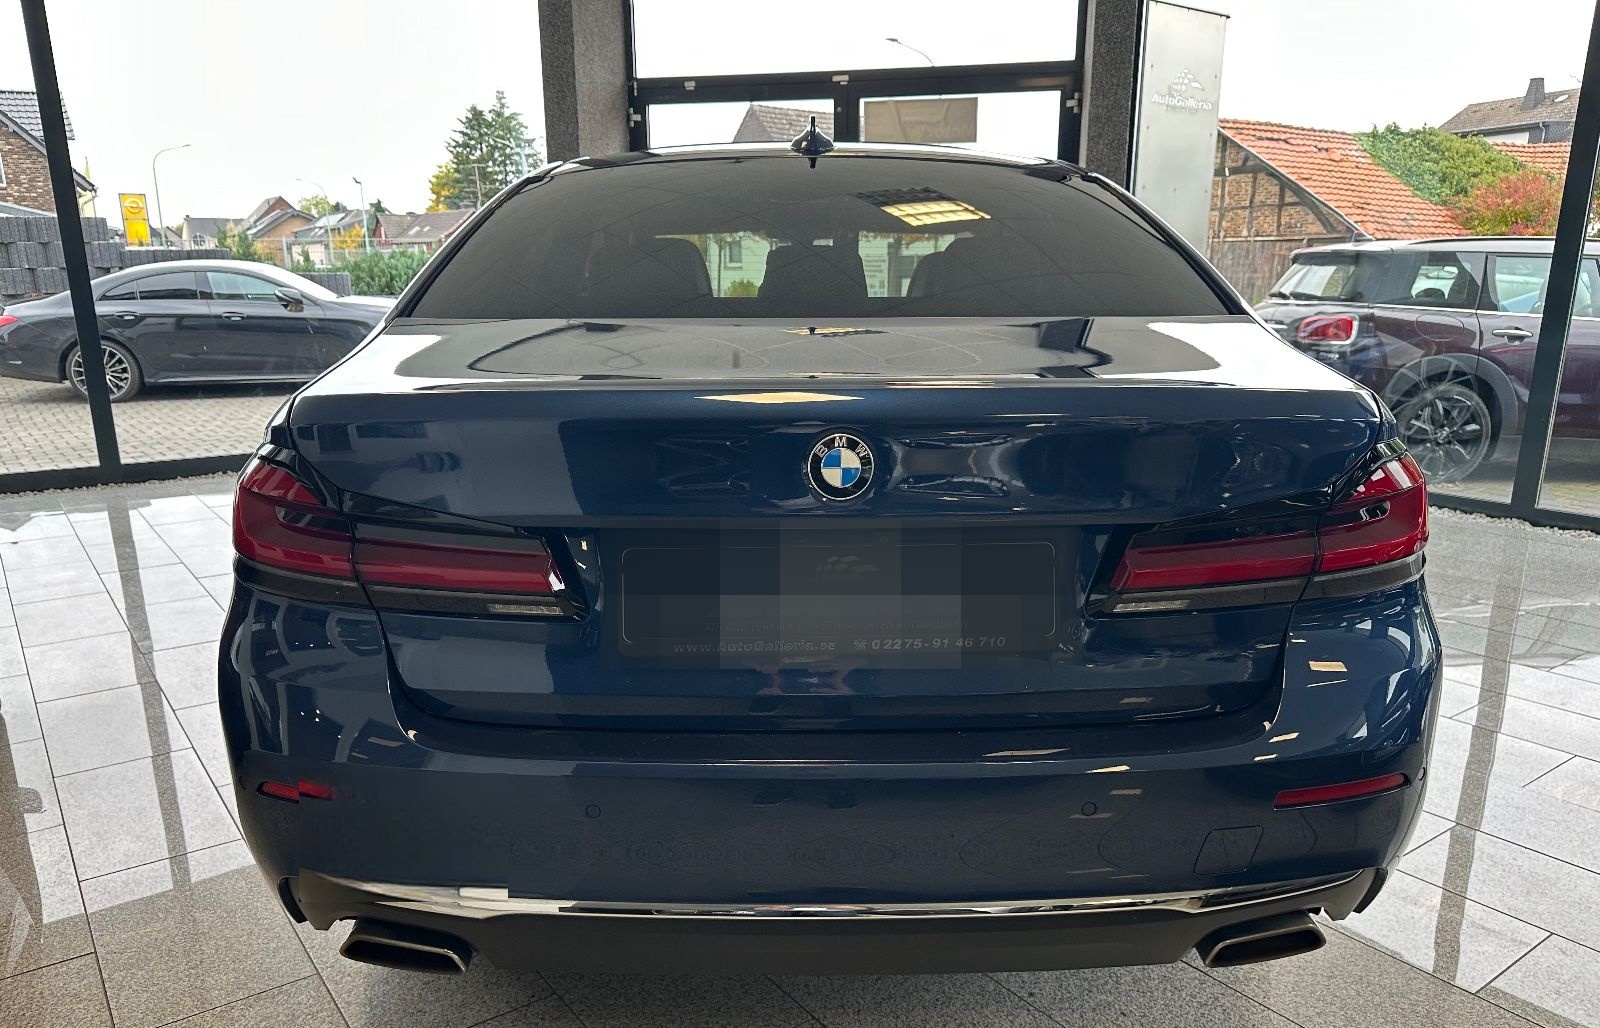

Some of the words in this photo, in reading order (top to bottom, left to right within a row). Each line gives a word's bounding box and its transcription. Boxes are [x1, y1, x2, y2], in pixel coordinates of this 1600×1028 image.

[1152, 93, 1212, 110] AutoGalleria
[815, 436, 869, 458] BMW
[979, 636, 1006, 648] 710
